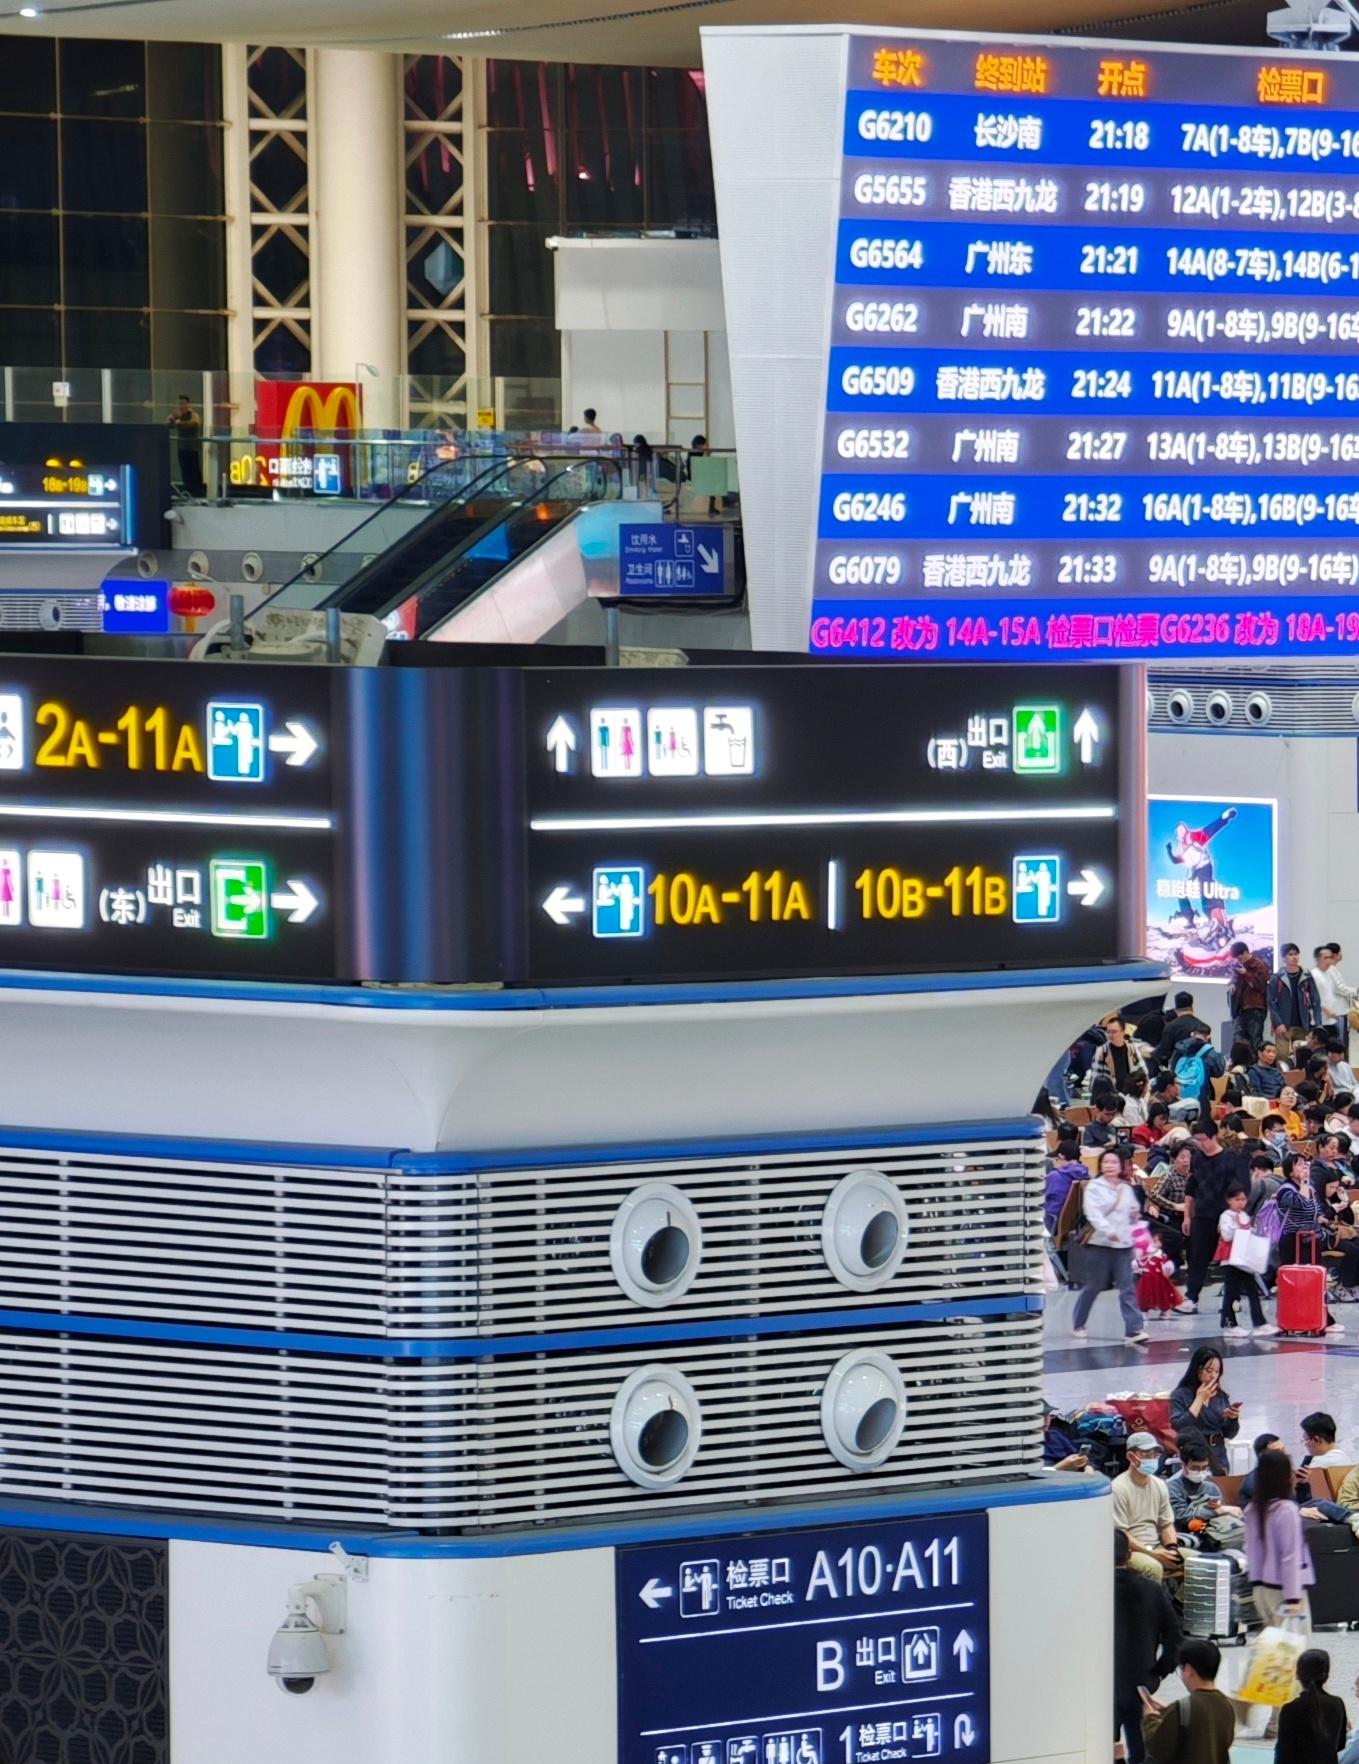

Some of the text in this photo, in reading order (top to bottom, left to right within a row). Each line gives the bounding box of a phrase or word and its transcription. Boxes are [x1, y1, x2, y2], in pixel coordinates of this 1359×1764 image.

[872, 50, 923, 87] 车次
[975, 56, 1046, 94] 终到站
[1099, 61, 1146, 98] 开点
[1258, 68, 1325, 105] 检票口
[858, 112, 932, 144] G6210
[974, 114, 1043, 150] 长沙南
[1089, 120, 1149, 151] 21:18
[854, 176, 926, 206] G5655
[948, 177, 1058, 214] 香港西九龙
[1085, 182, 1144, 212] 21:19
[829, 556, 901, 587] G6079
[922, 554, 1031, 587] 香港西九龙
[1058, 555, 1117, 584] 21:33
[36, 703, 202, 772] 2A-11A
[968, 716, 1009, 748] 出口
[982, 750, 1008, 769] Exit
[147, 866, 200, 906] 出口
[647, 866, 1007, 925] 10A-11A 10B-11B
[1203, 880, 1240, 900] Ultra
[173, 908, 200, 927] Exit
[726, 1557, 791, 1592] 检票口
[726, 1591, 794, 1611] Ticket Check
[816, 1637, 896, 1692] B 出口
[874, 1669, 896, 1686] Exit
[839, 1721, 907, 1764] 1 检票口
[855, 1746, 907, 1764] Ticket Check
